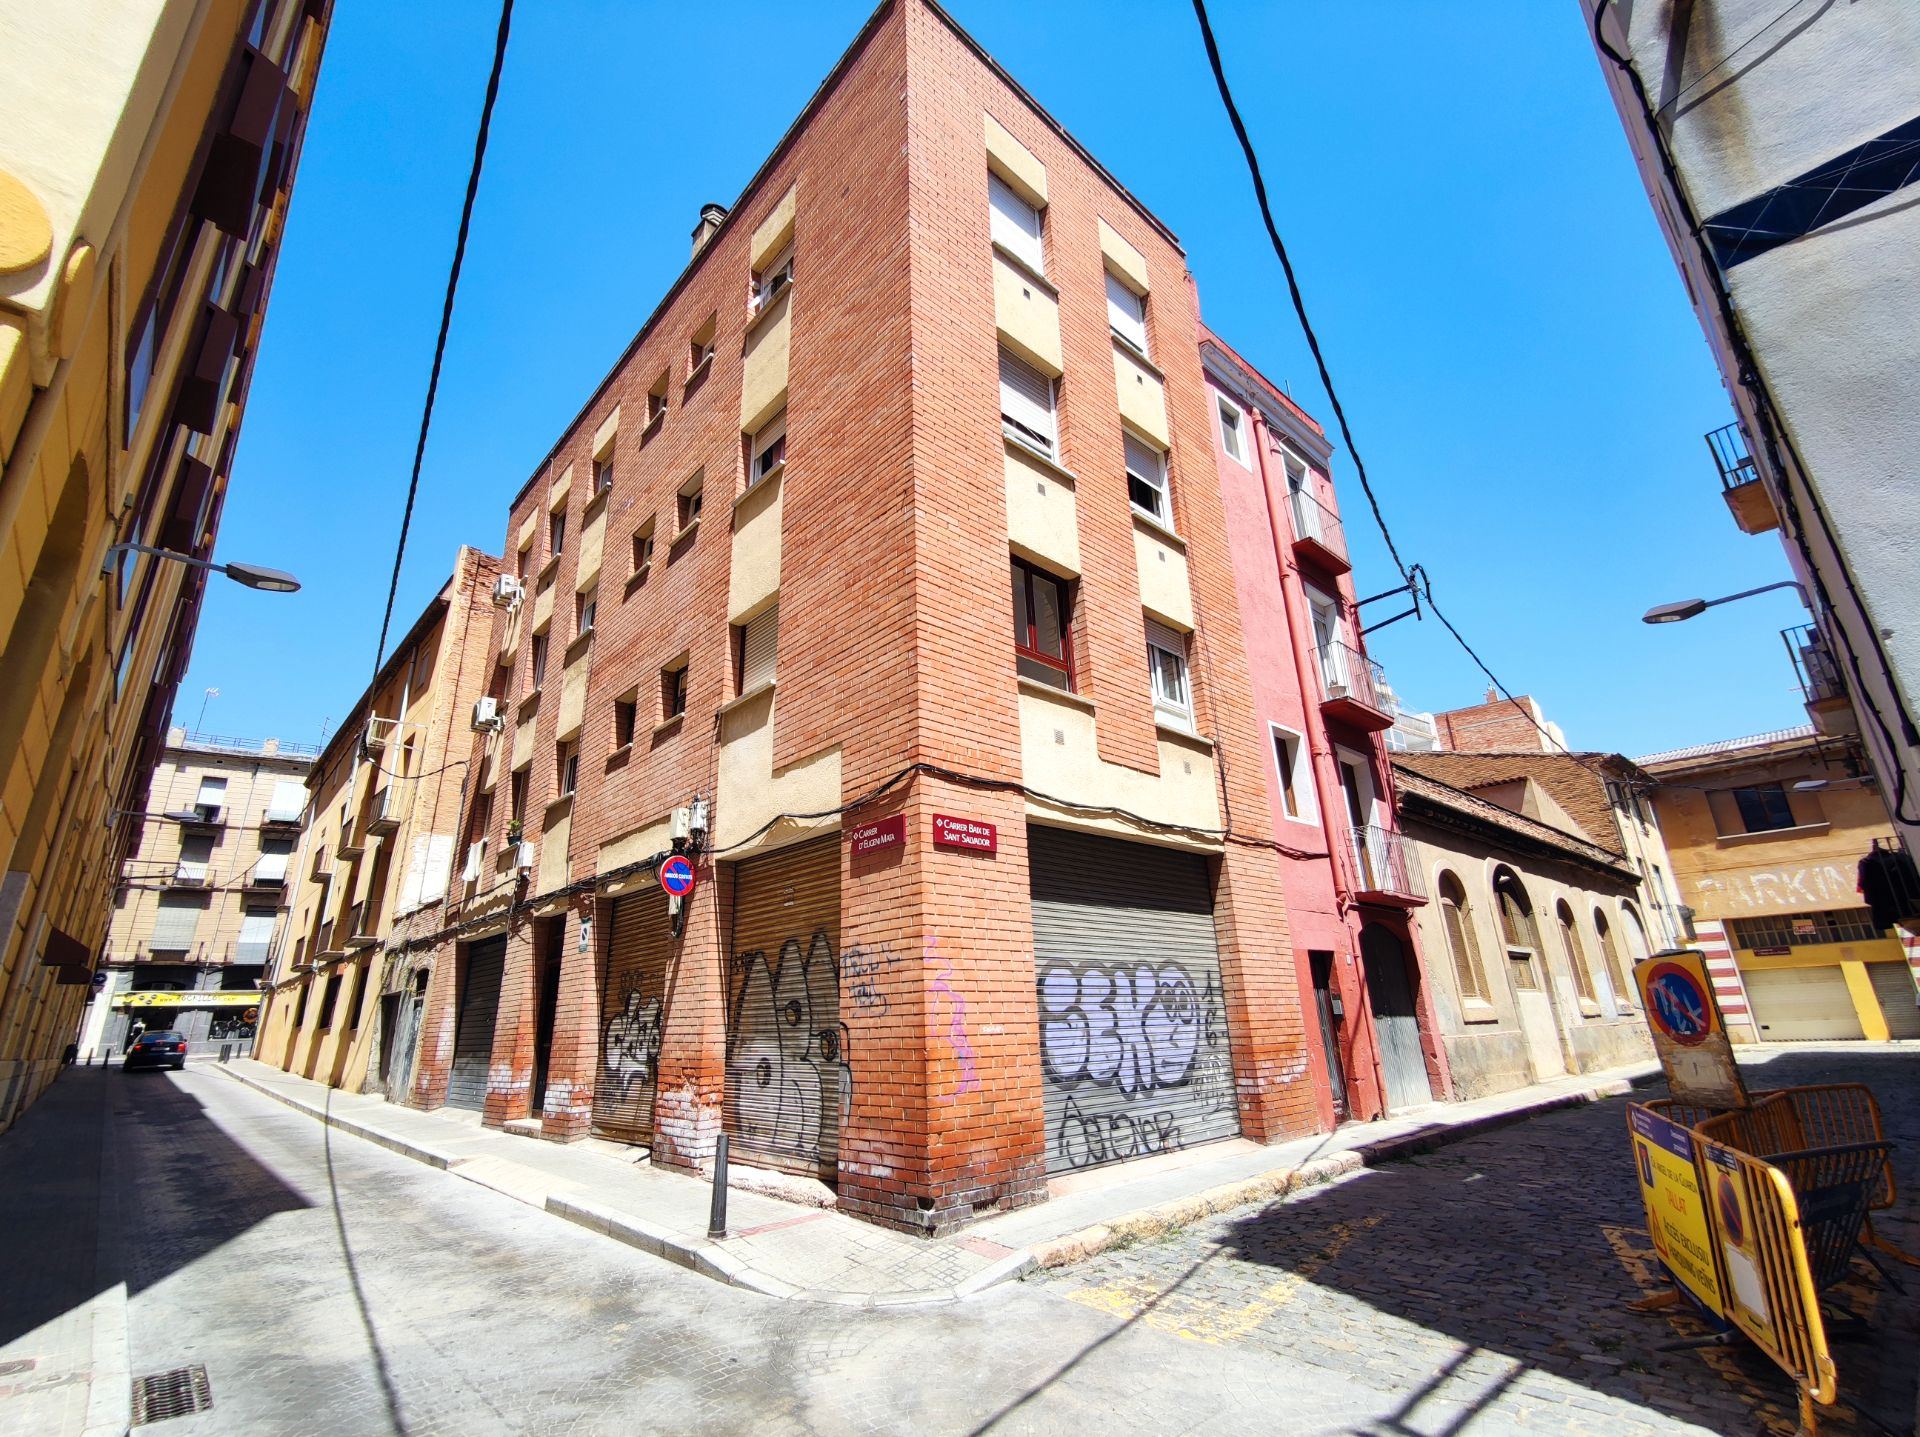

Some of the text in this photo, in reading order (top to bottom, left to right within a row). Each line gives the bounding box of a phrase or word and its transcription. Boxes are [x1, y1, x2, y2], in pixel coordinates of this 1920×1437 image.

[858, 827, 878, 839] CARRER
[944, 819, 991, 836] CARRER BAIX DE
[880, 833, 896, 844] MATA
[944, 830, 991, 847] SANT SALVADOR
